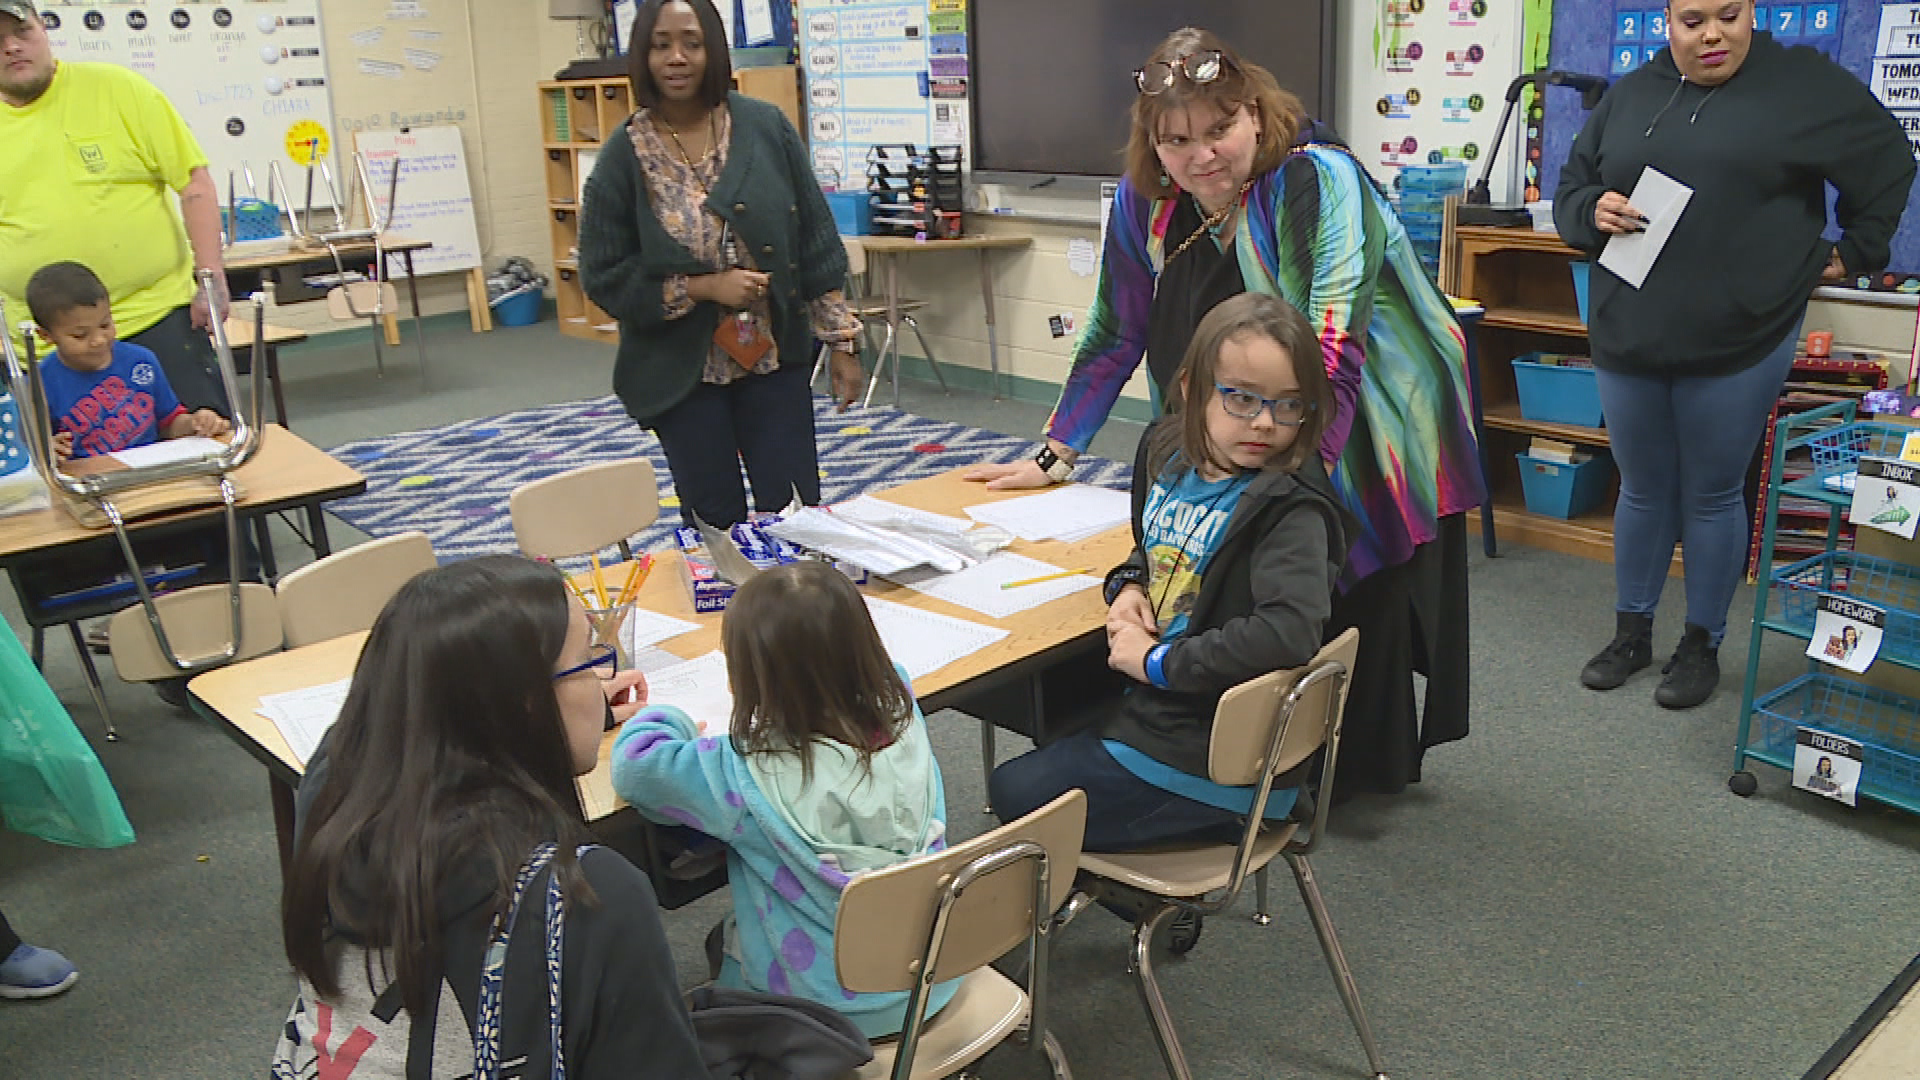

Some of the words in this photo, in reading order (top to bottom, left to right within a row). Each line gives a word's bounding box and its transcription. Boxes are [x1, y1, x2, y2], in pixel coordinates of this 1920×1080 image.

[1623, 17, 1635, 35] 2
[1652, 16, 1664, 34] 3
[1779, 12, 1793, 31] 7
[1814, 9, 1829, 29] 8
[1620, 49, 1632, 67] 9
[819, 121, 835, 131] MATH
[1881, 463, 1914, 481] INBOX
[1826, 597, 1877, 623] HOMEWORK
[1811, 735, 1850, 755] FOLDERS
